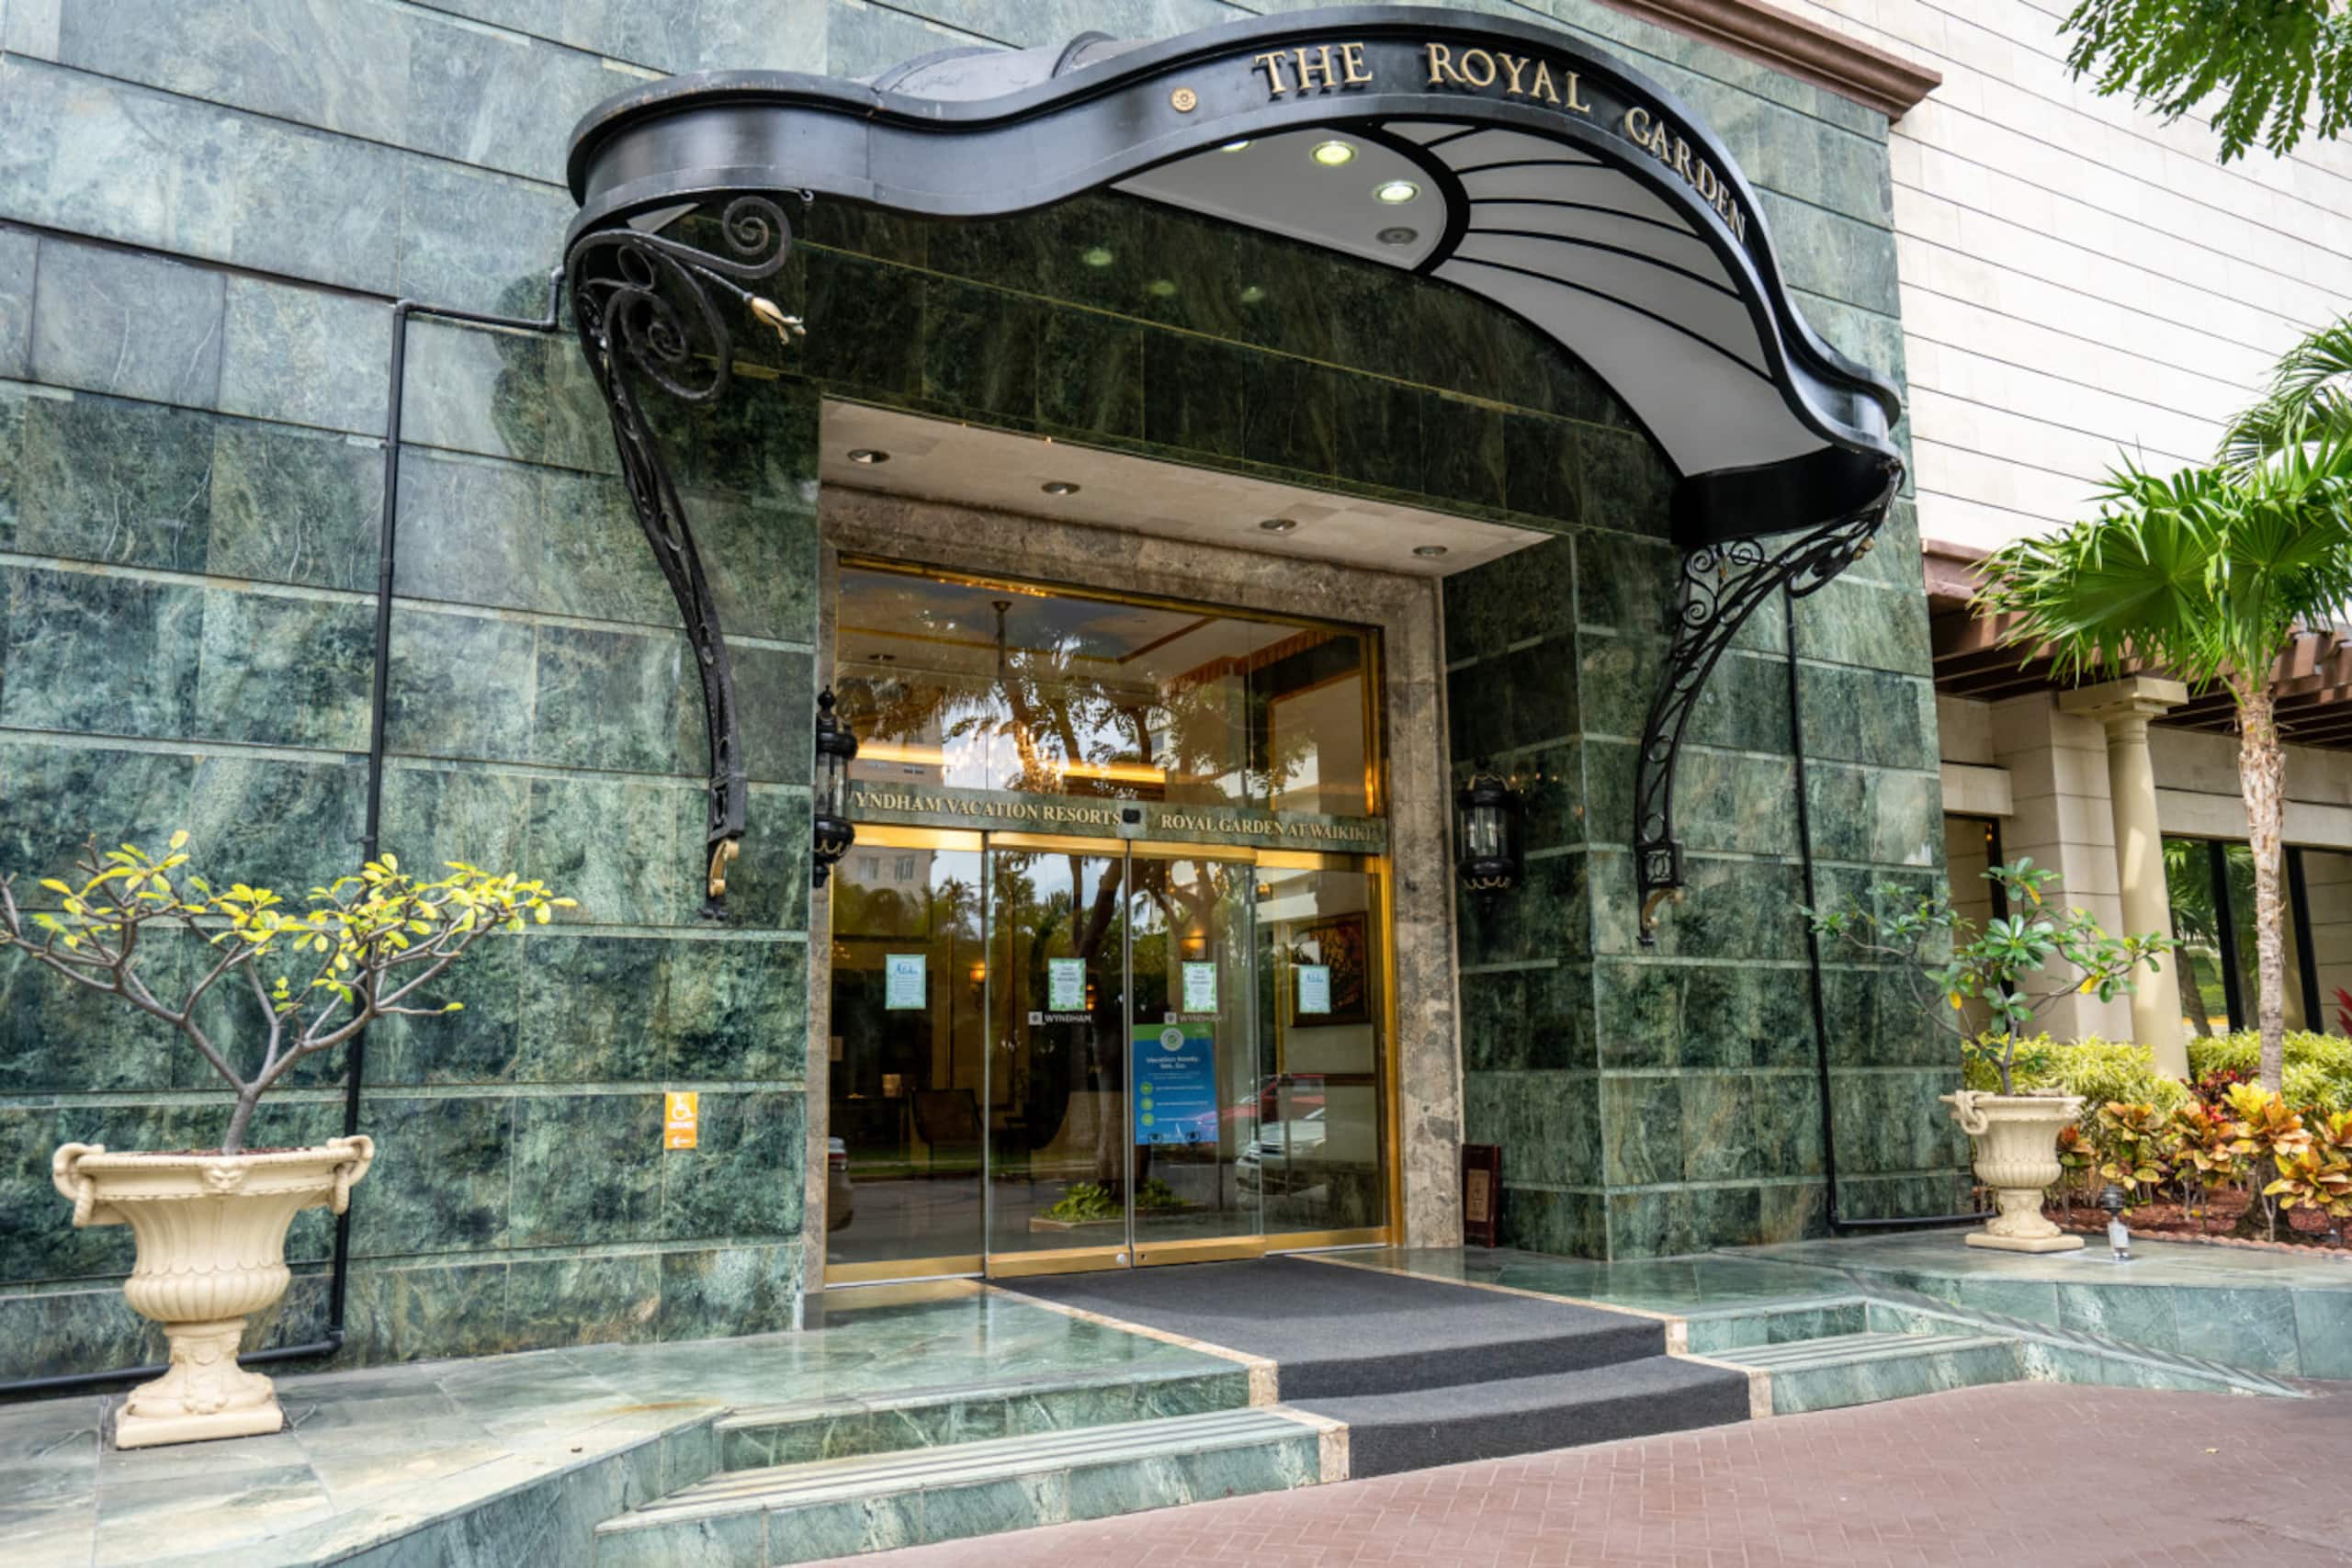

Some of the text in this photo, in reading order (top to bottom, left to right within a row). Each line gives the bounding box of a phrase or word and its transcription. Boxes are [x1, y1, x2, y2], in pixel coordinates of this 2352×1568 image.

[1255, 42, 1745, 243] THE ROYAL GARDEN
[847, 791, 1123, 825] YNDHAM VACATION RESORTS
[1160, 814, 1216, 831] ROYAL
[1218, 818, 1284, 835] GARDEN
[1288, 822, 1306, 837] AT
[1044, 1013, 1092, 1022] WYNDHAM
